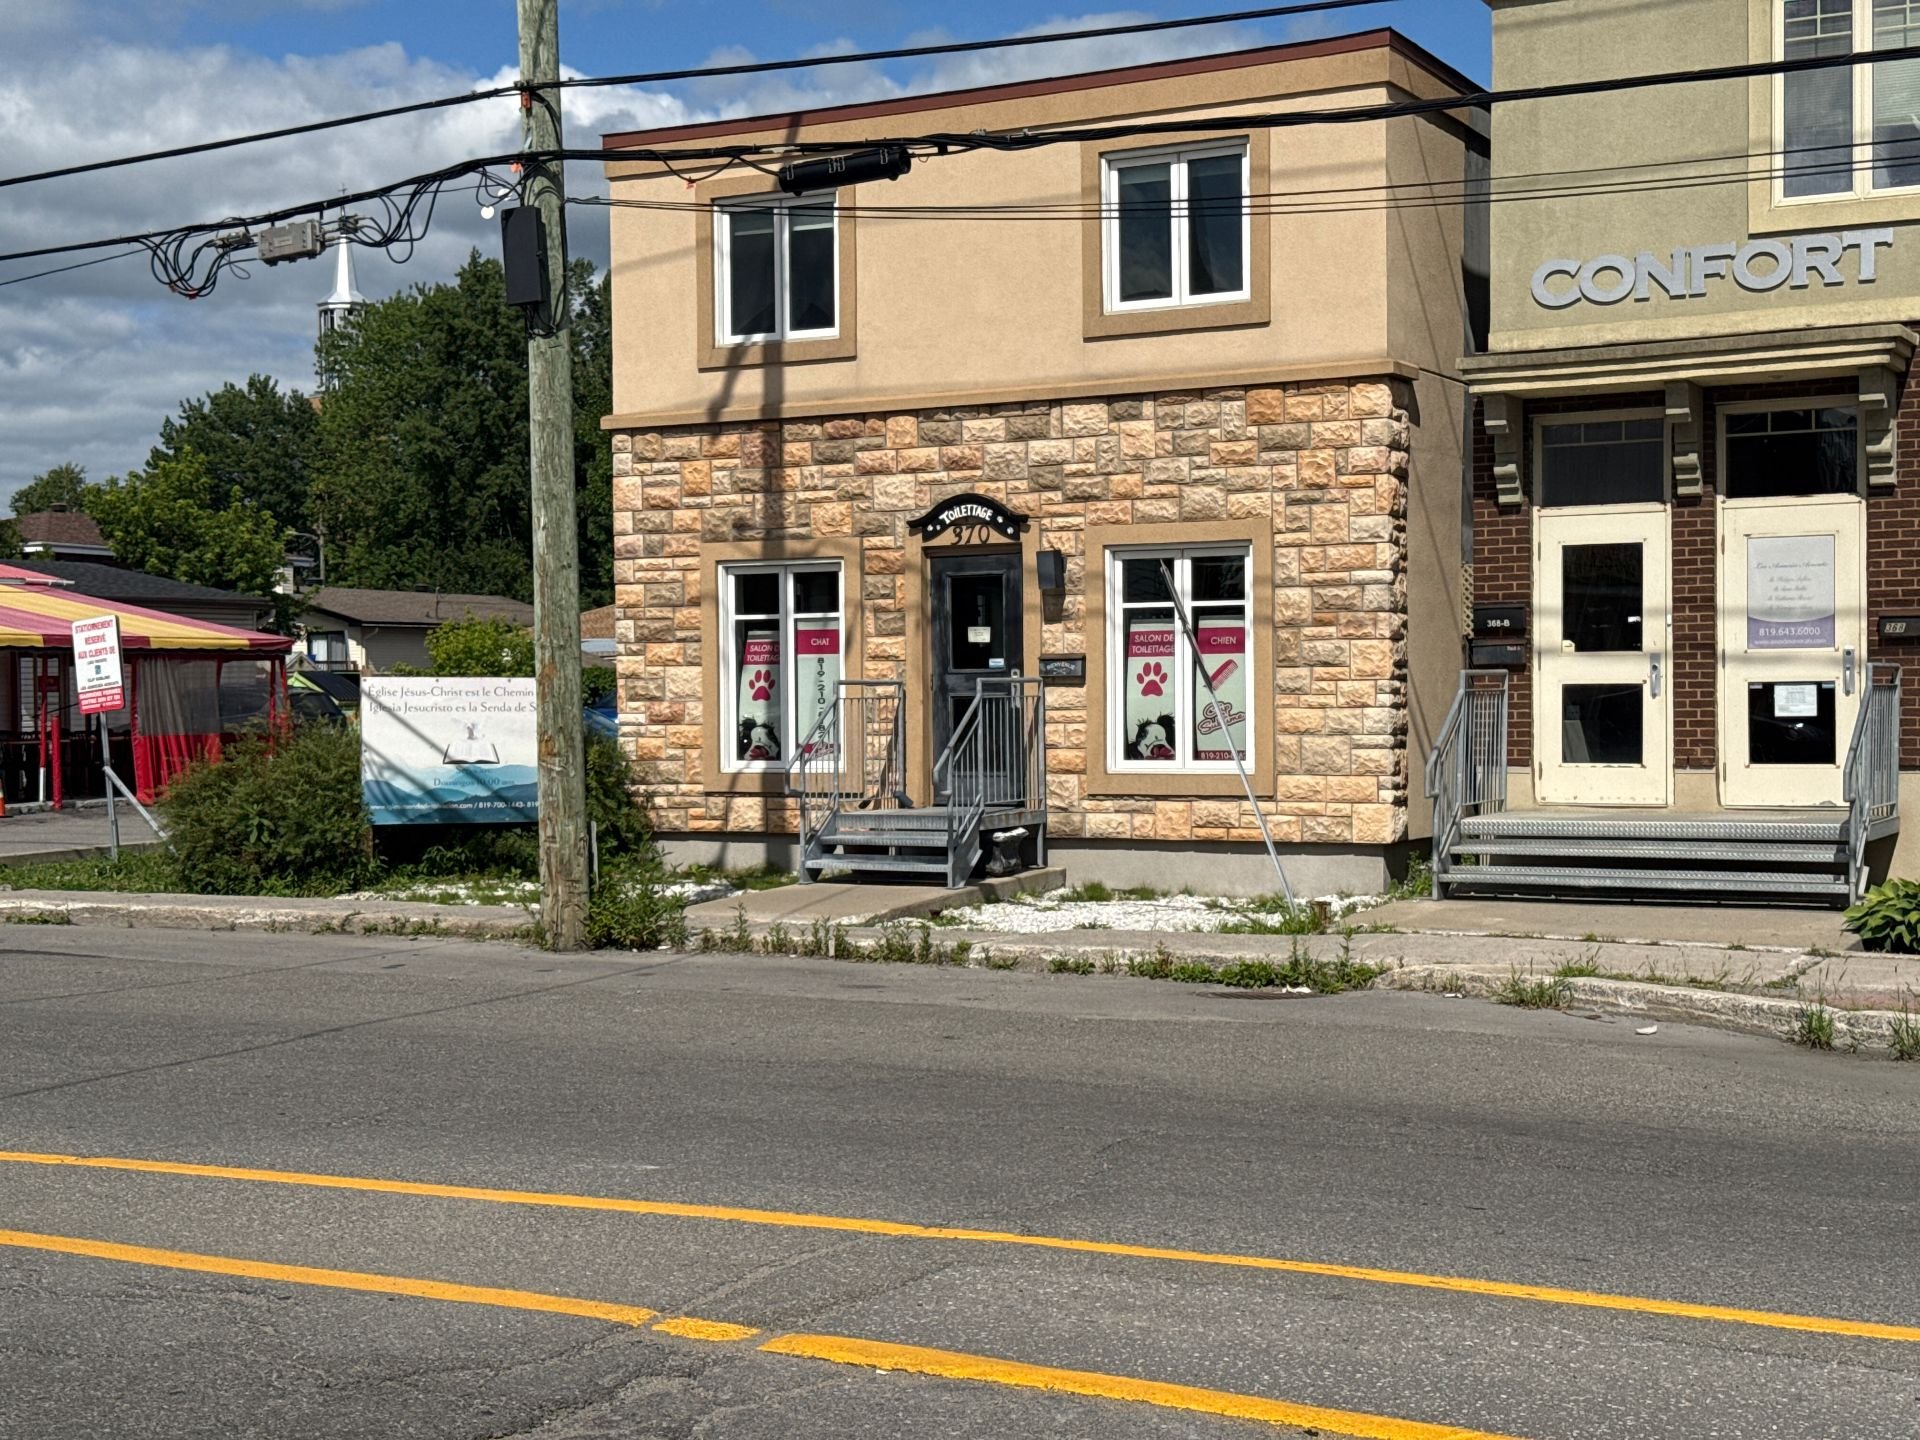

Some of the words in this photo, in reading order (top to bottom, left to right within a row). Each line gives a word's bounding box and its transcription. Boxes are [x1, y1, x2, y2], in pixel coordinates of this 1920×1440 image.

[1531, 228, 1893, 309] CONFORT
[951, 525, 991, 545] 370
[75, 620, 113, 634] STATIONNEMENT
[1487, 619, 1510, 627] 368-B
[1759, 626, 1821, 636] 819.643.6000
[810, 638, 830, 646] CHAT
[1134, 634, 1162, 643] SALON
[1163, 633, 1175, 642] DE
[1210, 636, 1237, 645] CHIEN
[89, 647, 108, 658] CLIENTS
[750, 644, 773, 652] SALON
[1132, 645, 1175, 654] TOILETTAGE
[747, 654, 780, 662] TOILETTAG
[368, 682, 398, 699] Église
[400, 685, 462, 699] Jésus-Christ
[465, 688, 480, 697] est
[483, 686, 491, 697] le
[494, 685, 534, 697] Chemin
[369, 702, 401, 715] Iglesia
[404, 702, 453, 714] Jesucristo
[455, 705, 467, 713] es
[469, 702, 478, 713] la
[481, 702, 511, 713] Senda
[514, 702, 527, 713] de
